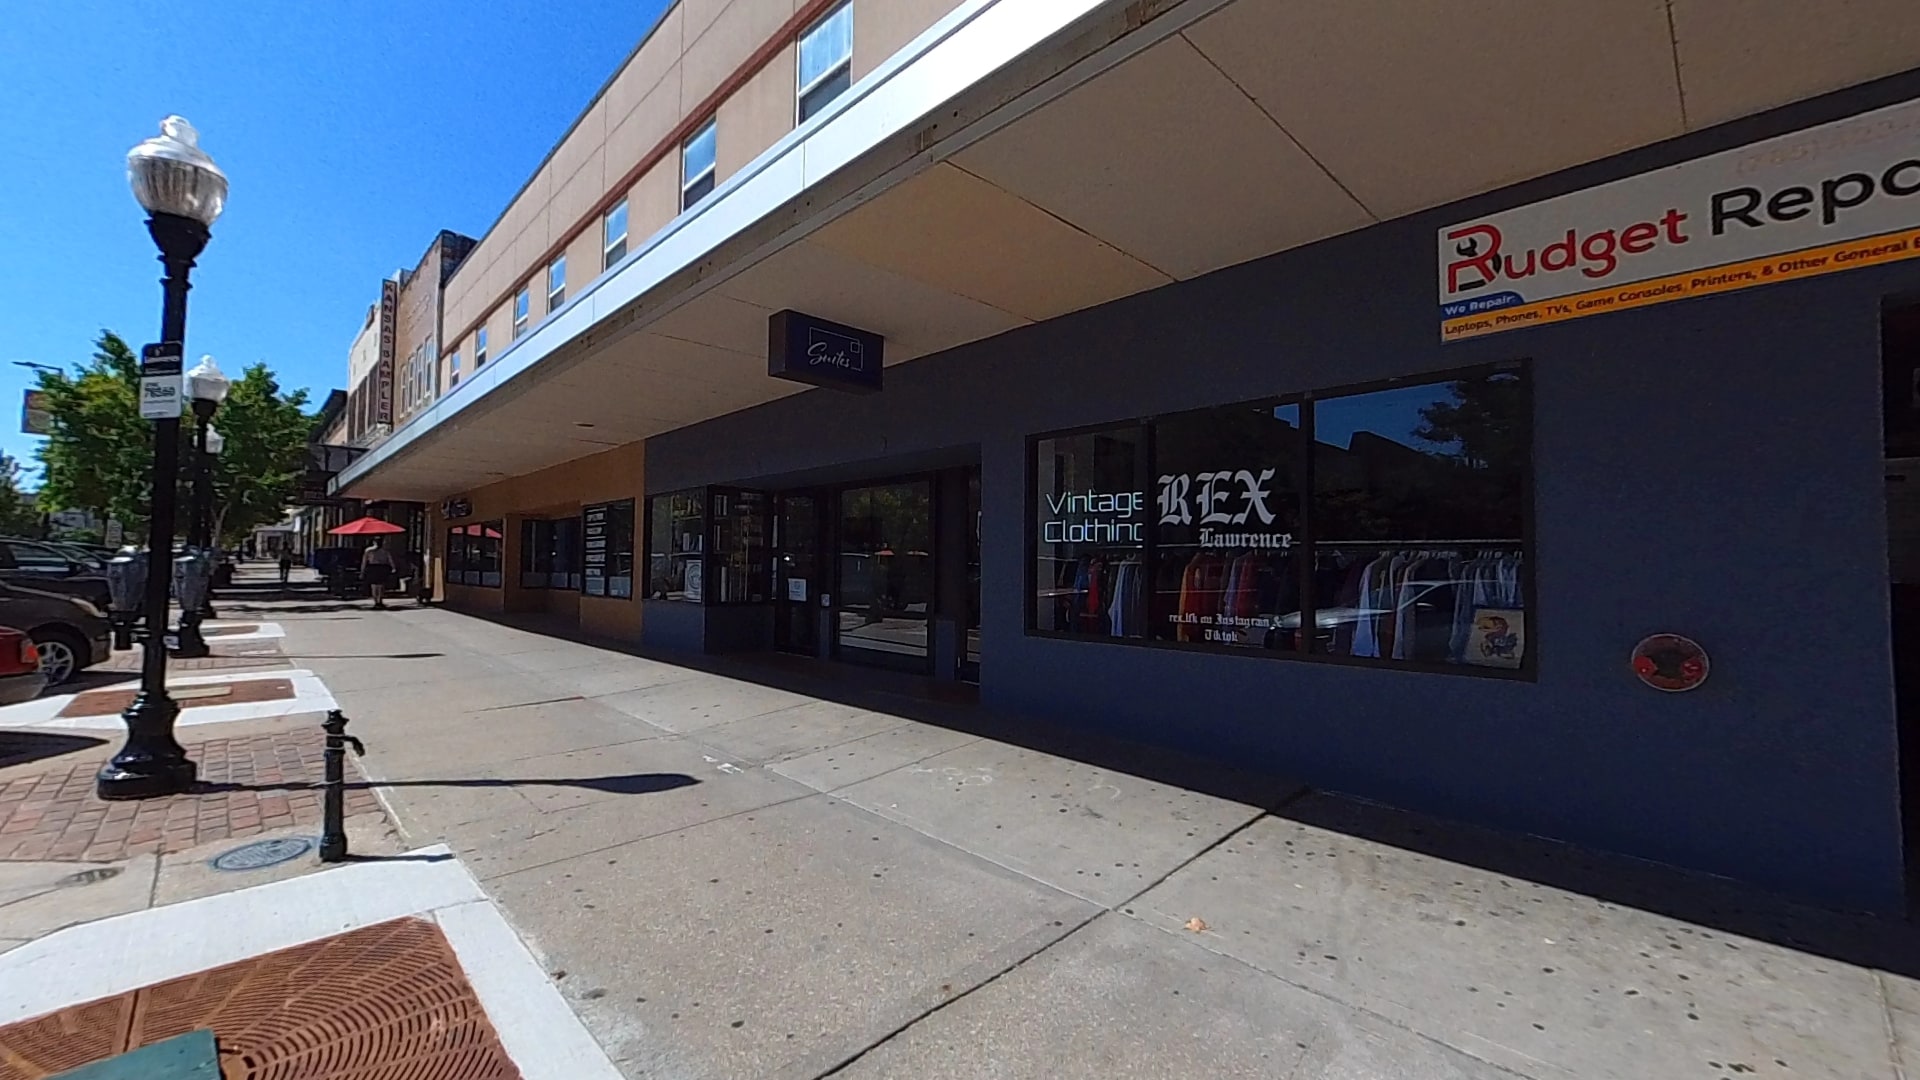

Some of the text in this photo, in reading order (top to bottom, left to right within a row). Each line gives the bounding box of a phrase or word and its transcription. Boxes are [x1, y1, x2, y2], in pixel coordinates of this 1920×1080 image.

[1444, 318, 1493, 335] Laptops,
[1495, 309, 1542, 325] Phones,
[1546, 303, 1572, 316] TVs,
[1575, 295, 1614, 310] Game
[1618, 282, 1687, 302] Consoles,
[1691, 270, 1757, 290] Printers,
[1762, 265, 1774, 276] &
[1778, 256, 1829, 274] Other
[1834, 239, 1908, 262] General
[1444, 304, 1466, 316] We
[807, 341, 850, 369] Suites
[1045, 488, 1144, 519] Vintage
[1156, 466, 1278, 527] REX
[1198, 527, 1293, 549] Lawrence
[1215, 612, 1270, 629] Instagram
